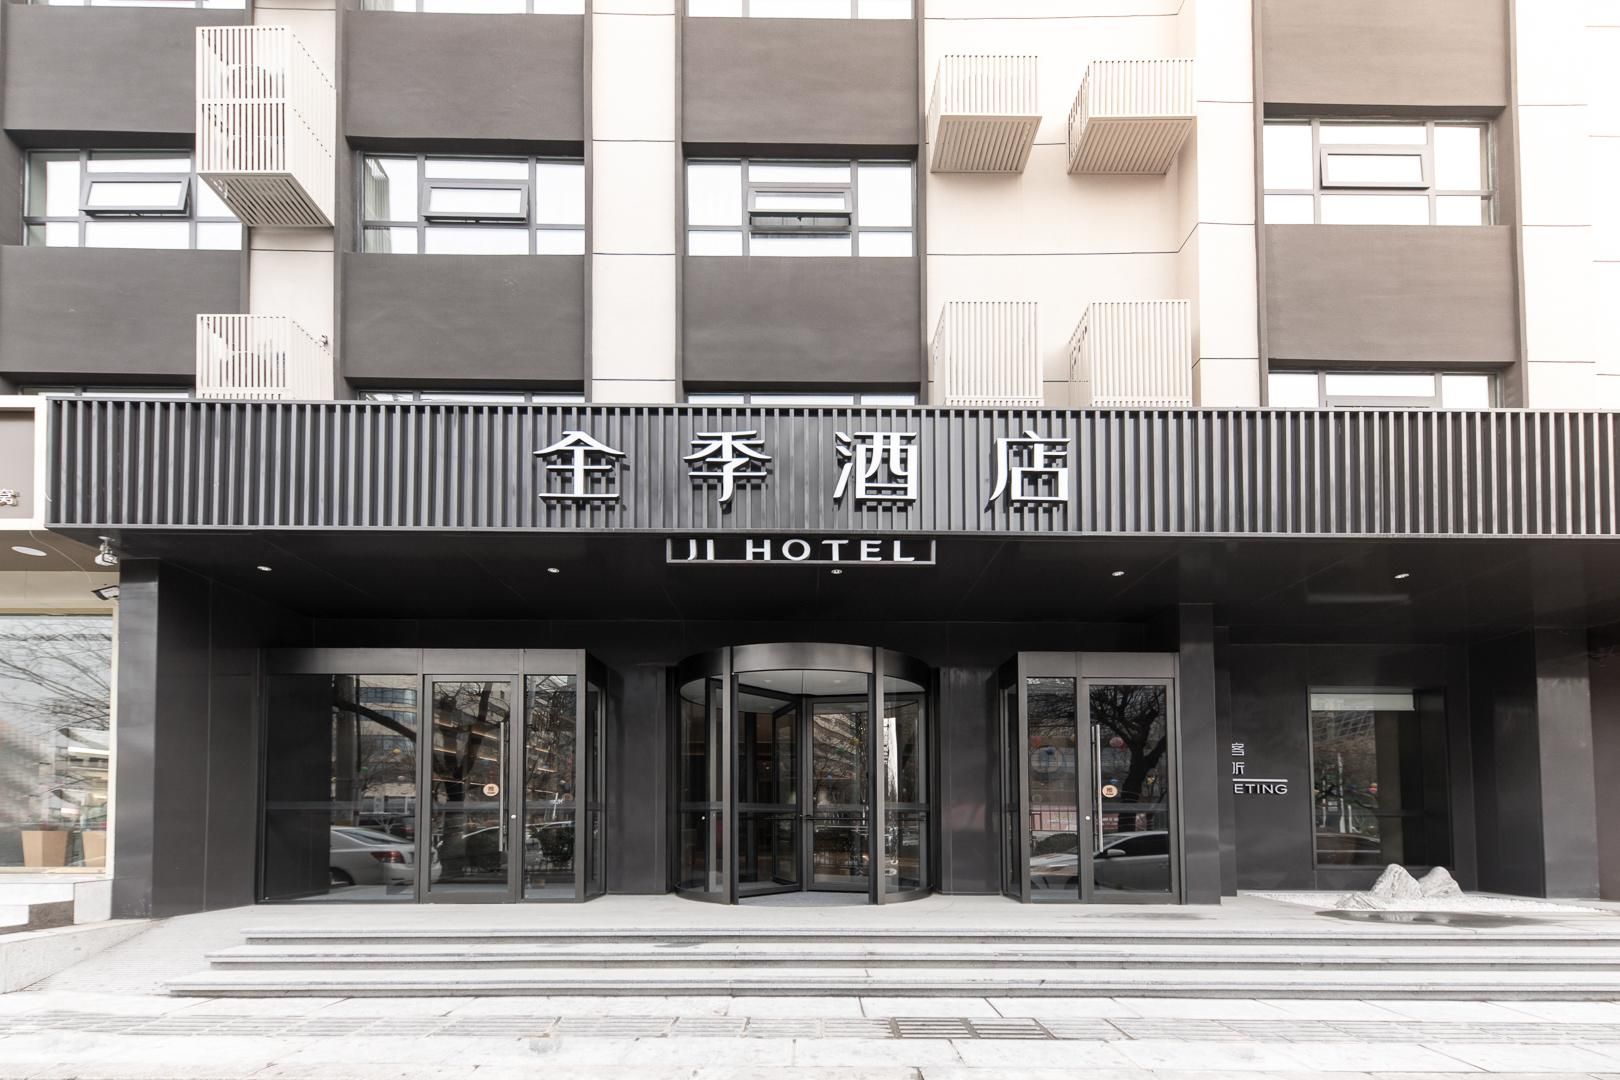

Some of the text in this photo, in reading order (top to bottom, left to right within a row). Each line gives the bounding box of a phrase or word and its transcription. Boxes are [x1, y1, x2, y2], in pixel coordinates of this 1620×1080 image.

[533, 430, 1072, 504] 全季酒店
[687, 539, 915, 562] JI HOTEL
[1234, 783, 1288, 795] ETING
